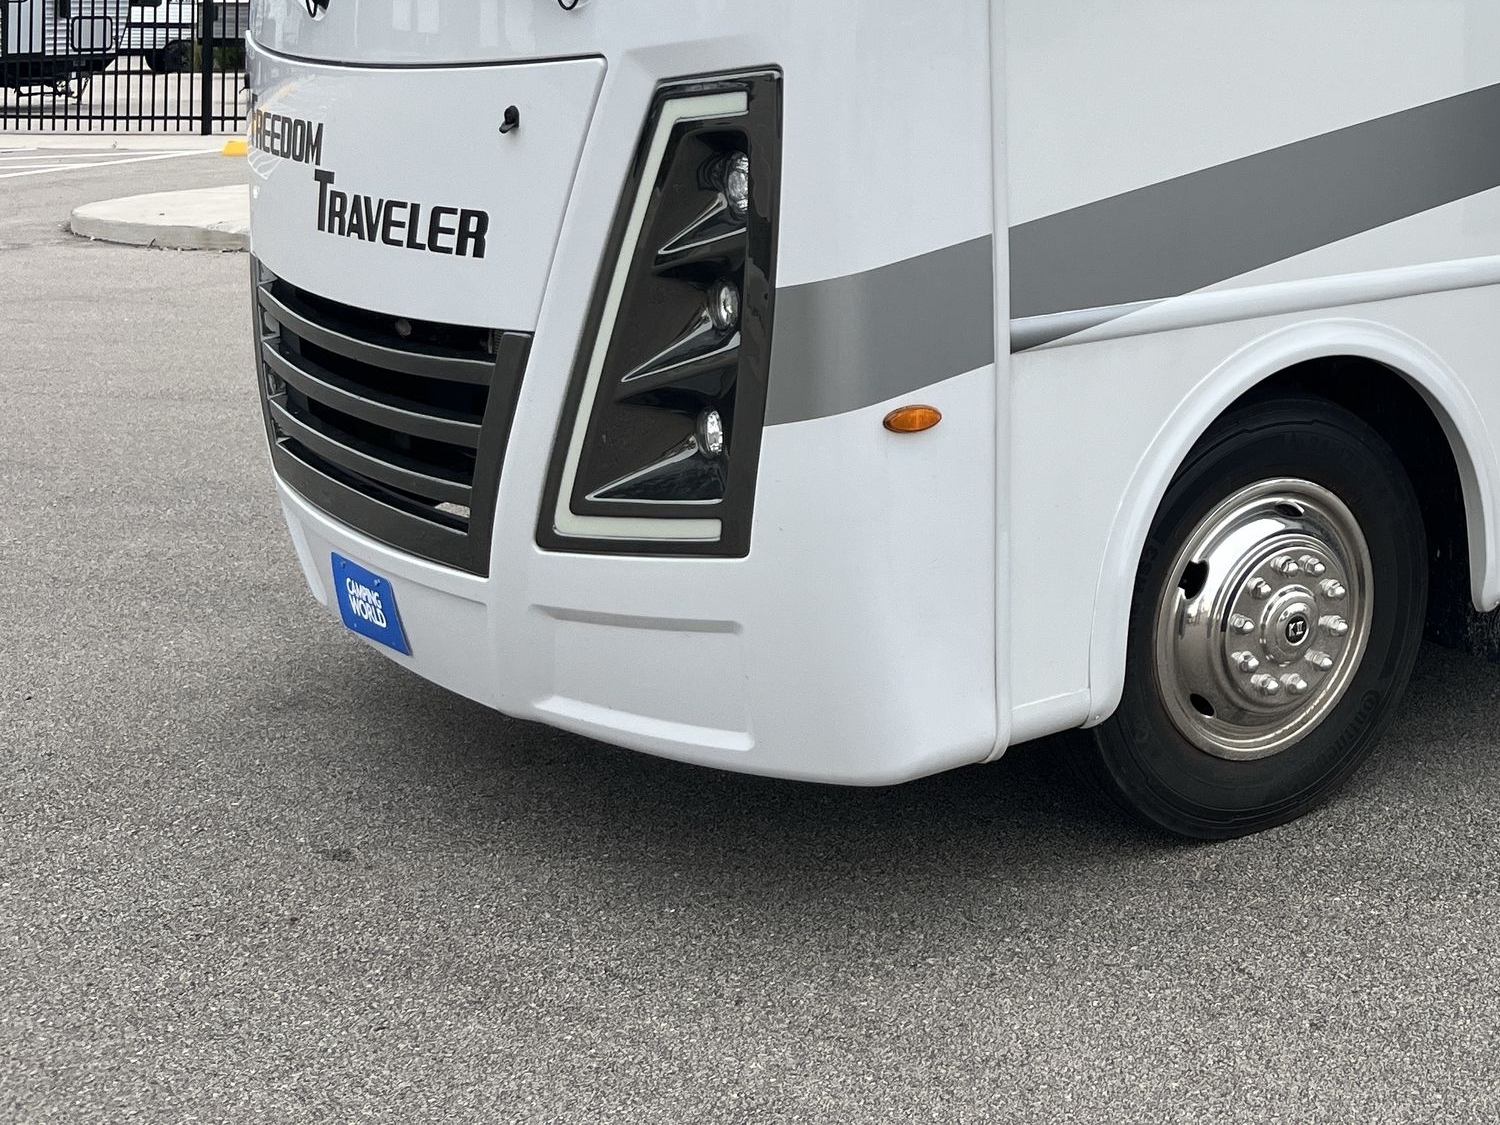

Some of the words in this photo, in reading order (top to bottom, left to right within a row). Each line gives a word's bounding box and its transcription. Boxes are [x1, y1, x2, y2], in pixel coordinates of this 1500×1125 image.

[251, 93, 324, 166] FREEDOM
[314, 169, 489, 259] TRAVELER
[346, 577, 382, 609] CAMPING
[349, 594, 387, 628] WORLD
